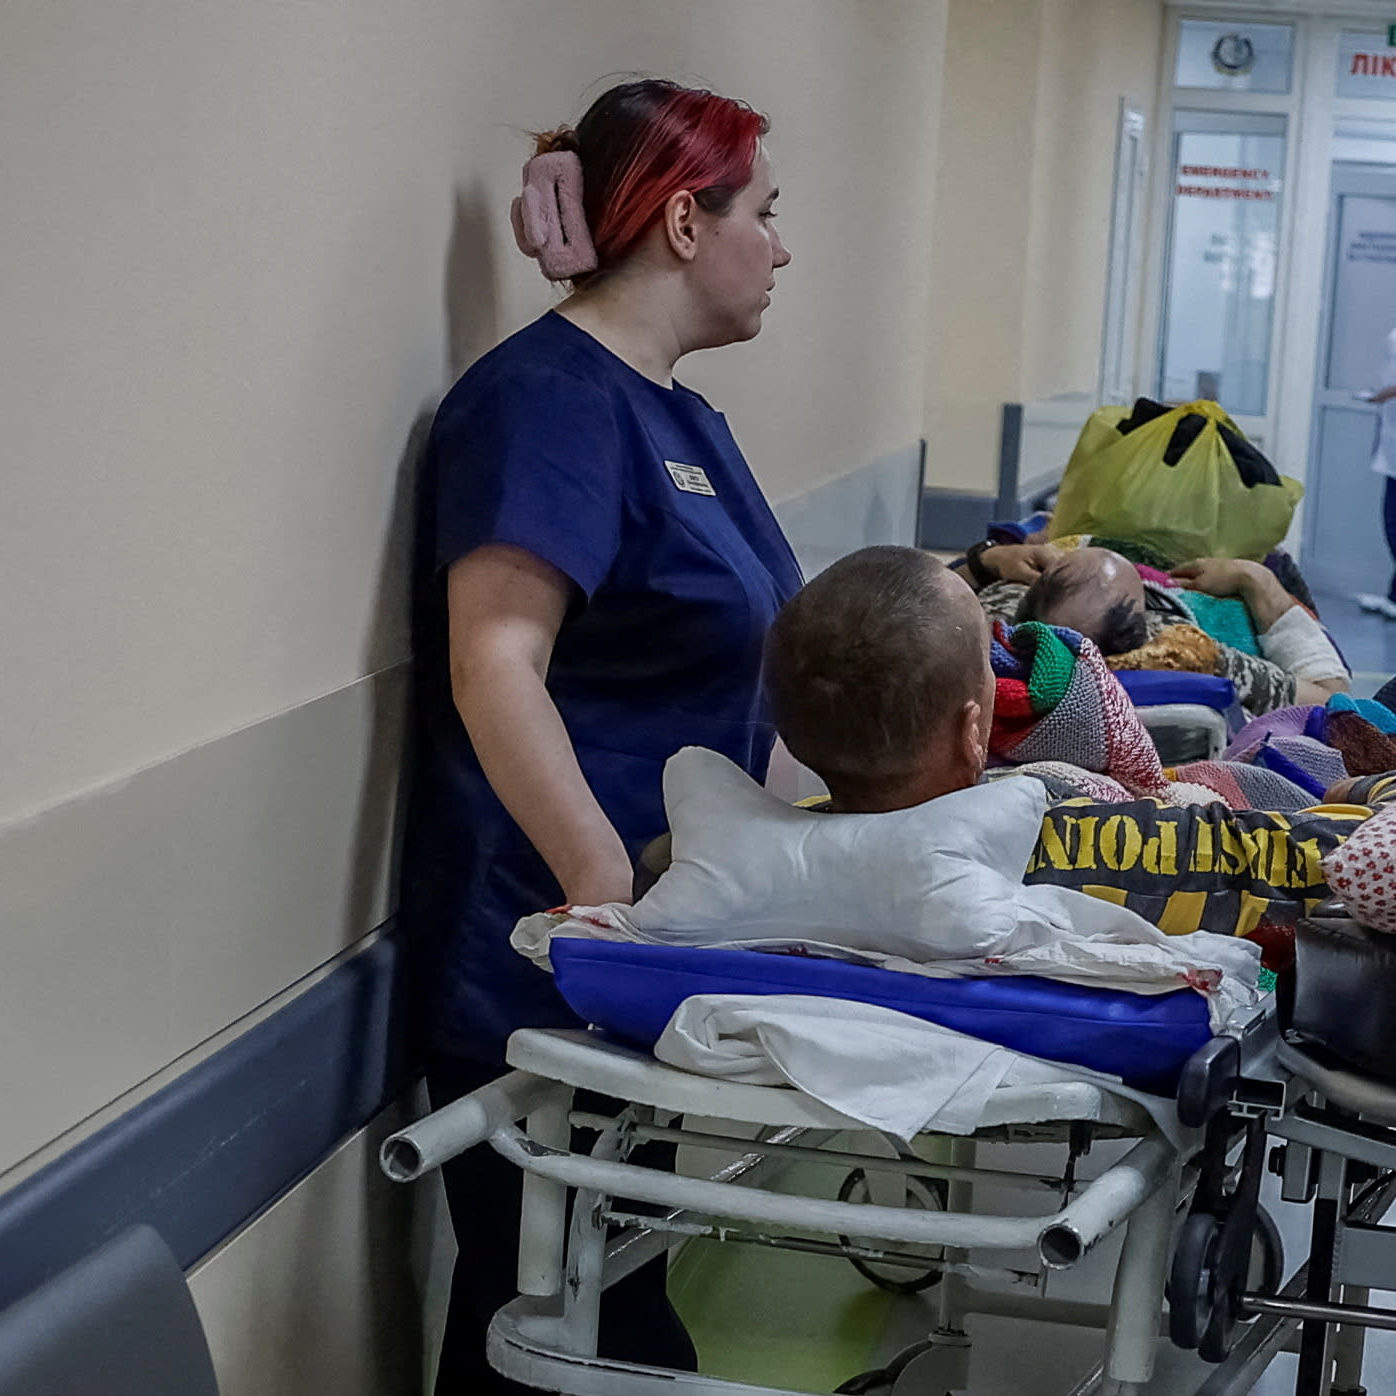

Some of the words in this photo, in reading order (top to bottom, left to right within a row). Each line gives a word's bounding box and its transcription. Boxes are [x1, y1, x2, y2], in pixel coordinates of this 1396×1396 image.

[1181, 165, 1269, 180] EMERGENCY
[1177, 184, 1273, 200] DEPARTMENT
[1026, 814, 1179, 876] POIN
